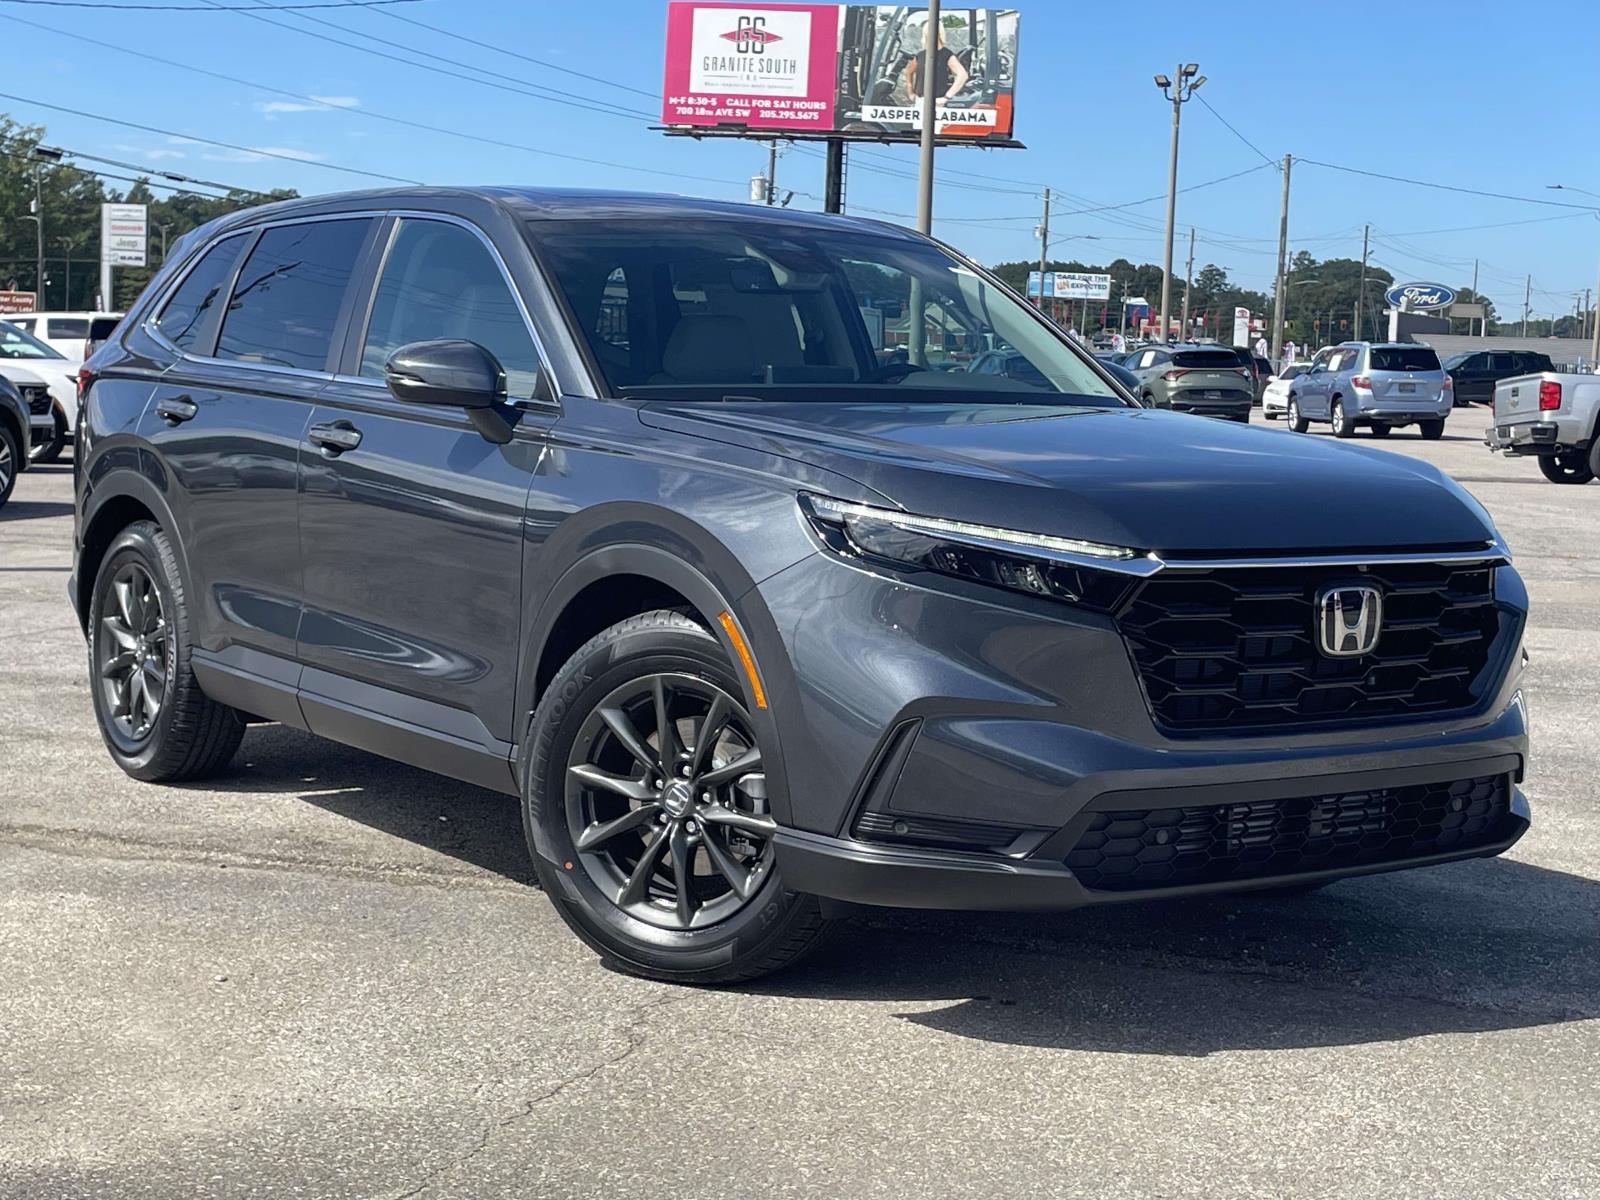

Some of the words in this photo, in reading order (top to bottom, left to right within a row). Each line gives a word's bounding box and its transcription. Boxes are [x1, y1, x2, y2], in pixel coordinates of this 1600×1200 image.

[703, 56, 754, 73] GRANITE
[758, 58, 796, 74] SOUTH
[669, 96, 686, 104] M-F
[688, 96, 717, 106] 8:30-5
[726, 98, 750, 107] CALL
[752, 99, 771, 107] FOR
[773, 100, 791, 109] SAT
[793, 101, 827, 110] HOURS
[676, 106, 693, 115] 700
[715, 108, 733, 116] AVE
[735, 108, 751, 117] SW
[870, 109, 920, 120] JASPER
[934, 111, 987, 122] LABAMA
[1403, 287, 1442, 304] Ford
